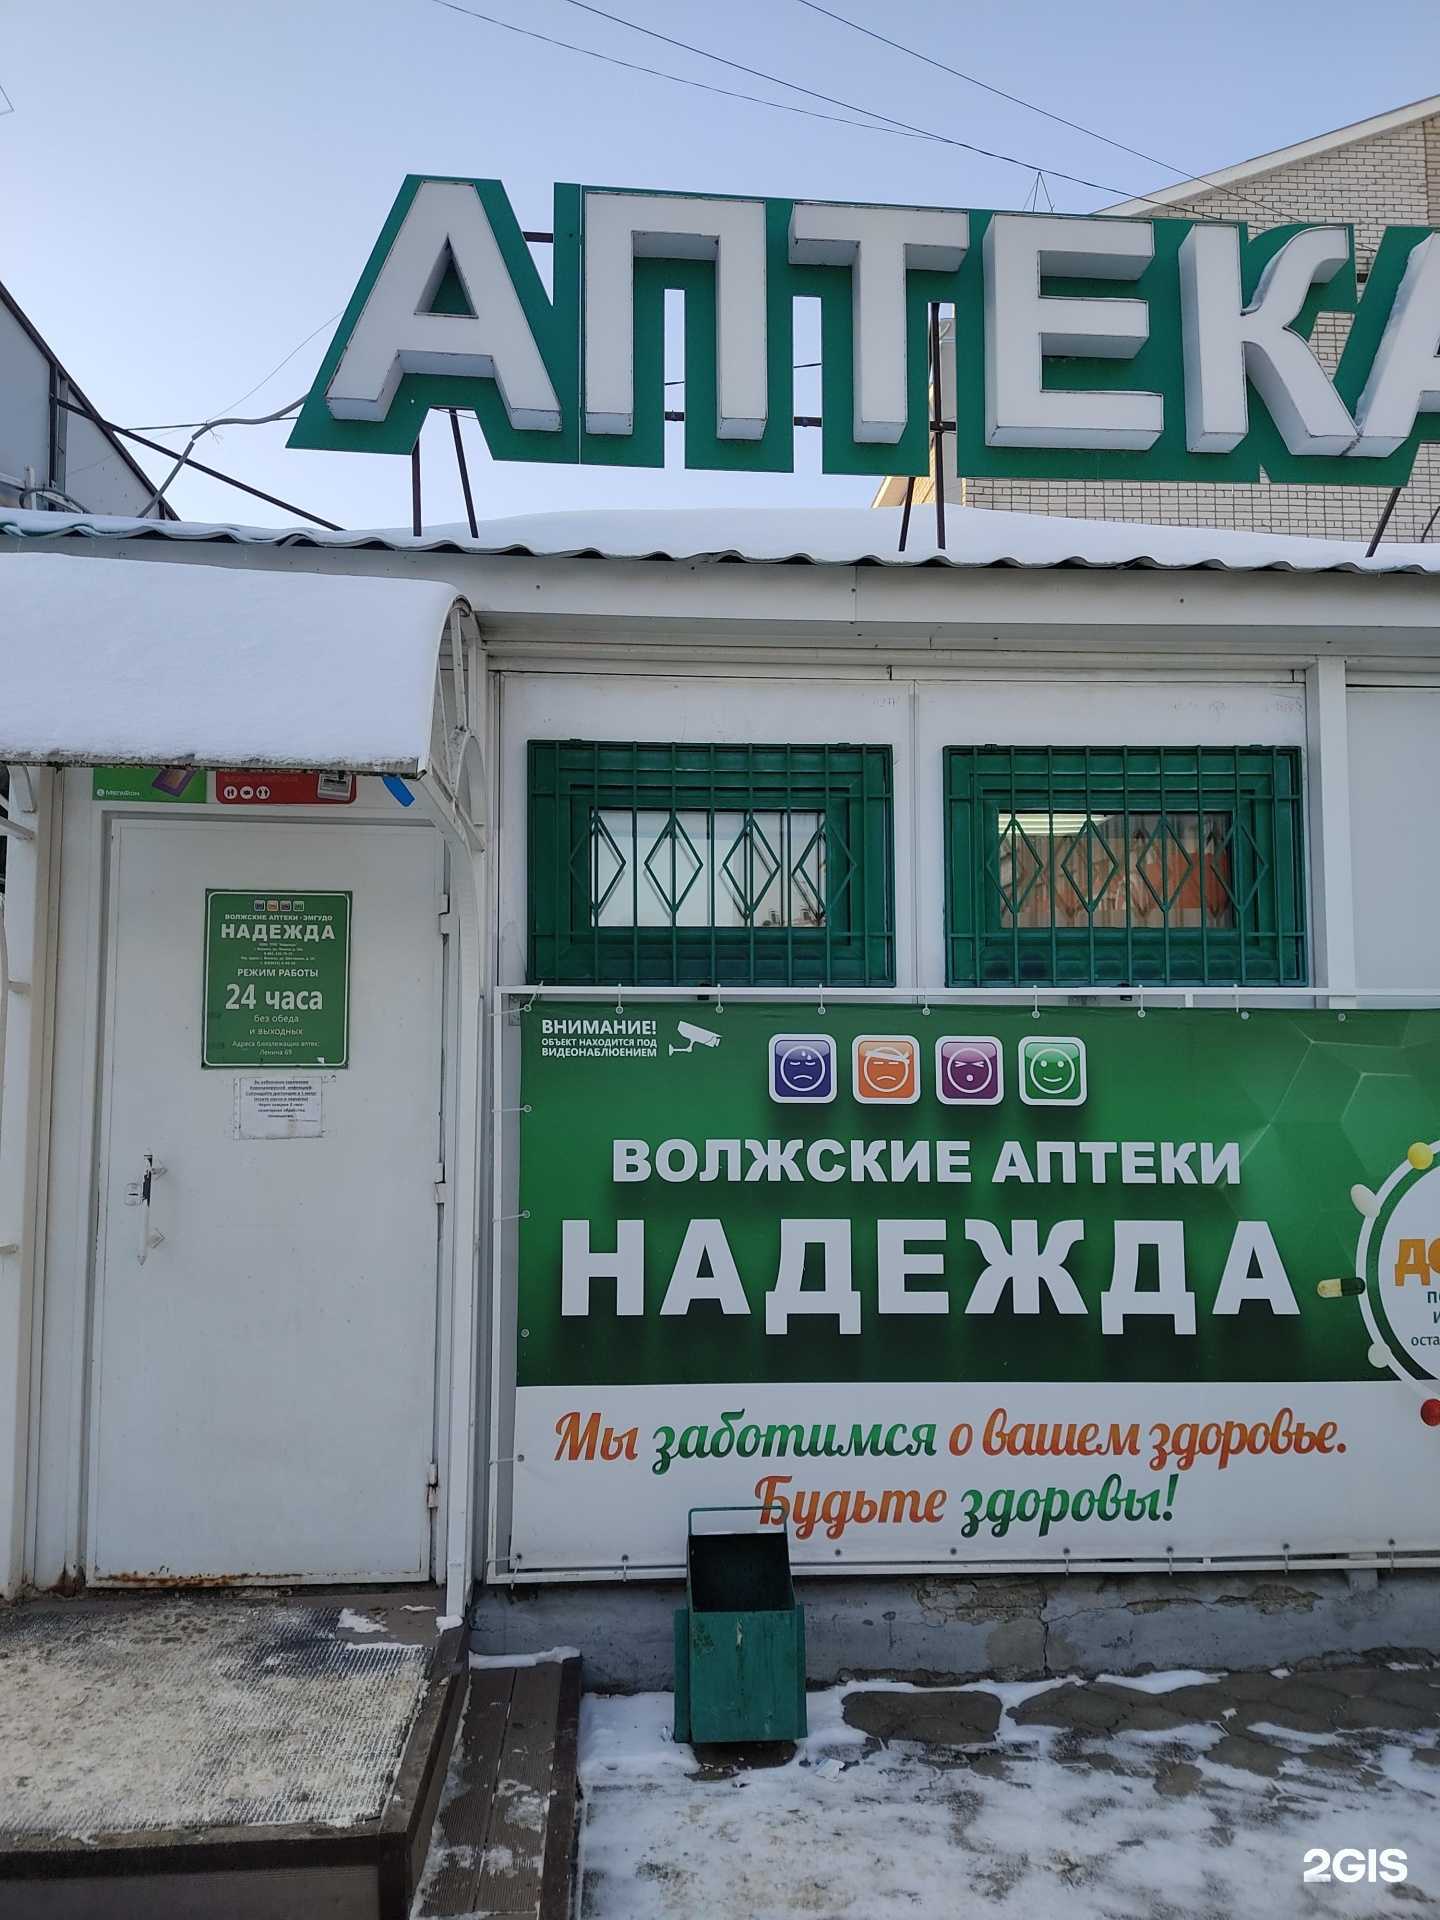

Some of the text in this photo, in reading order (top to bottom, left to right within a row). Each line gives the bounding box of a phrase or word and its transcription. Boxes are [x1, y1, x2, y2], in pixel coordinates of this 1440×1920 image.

[221, 923, 335, 942] НАДЕЖДА
[237, 968, 319, 977] РЕЖИМ РАБОТЫ
[225, 983, 323, 1010] 24 часа
[254, 1014, 299, 1024] без обеда
[542, 1019, 657, 1035] ВНИМАНИЕ!
[258, 1028, 304, 1037] выходных
[541, 1038, 657, 1048] ОБЪЕКТ НАХОДИТСЯ ПОД
[611, 1138, 1242, 1186] ВОЛЖСКИЕ АПТЕКИ
[560, 1218, 1301, 1336] НАДЕЖДА
[554, 1407, 1347, 1476] Мы заботимся о вашем здоровье.
[754, 1473, 1179, 1541] Будьте здоровы!
